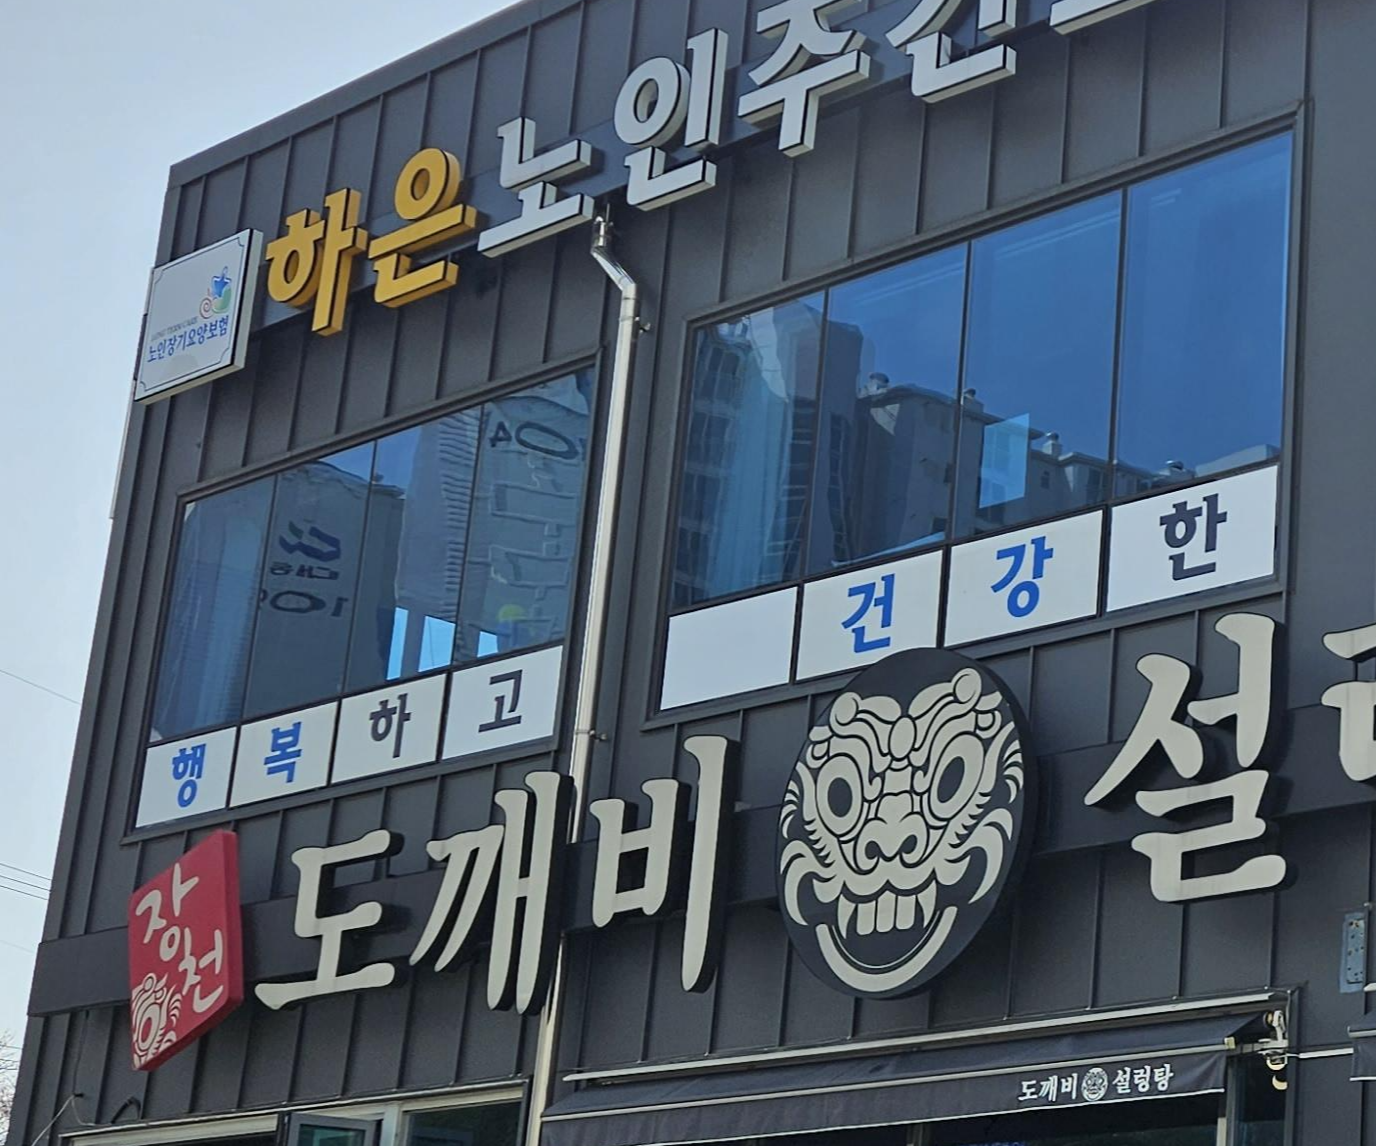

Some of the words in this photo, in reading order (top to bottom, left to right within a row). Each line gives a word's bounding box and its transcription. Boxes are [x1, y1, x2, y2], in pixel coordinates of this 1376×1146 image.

[266, 147, 477, 335] 하은
[147, 314, 229, 363] 노인장기요양보험
[840, 493, 1227, 654] 건강한
[171, 669, 523, 809] 행복하고
[255, 735, 729, 1015] 도깨비
[1018, 1072, 1079, 1102] 도깨비
[1112, 1063, 1175, 1095] 설렁탕
